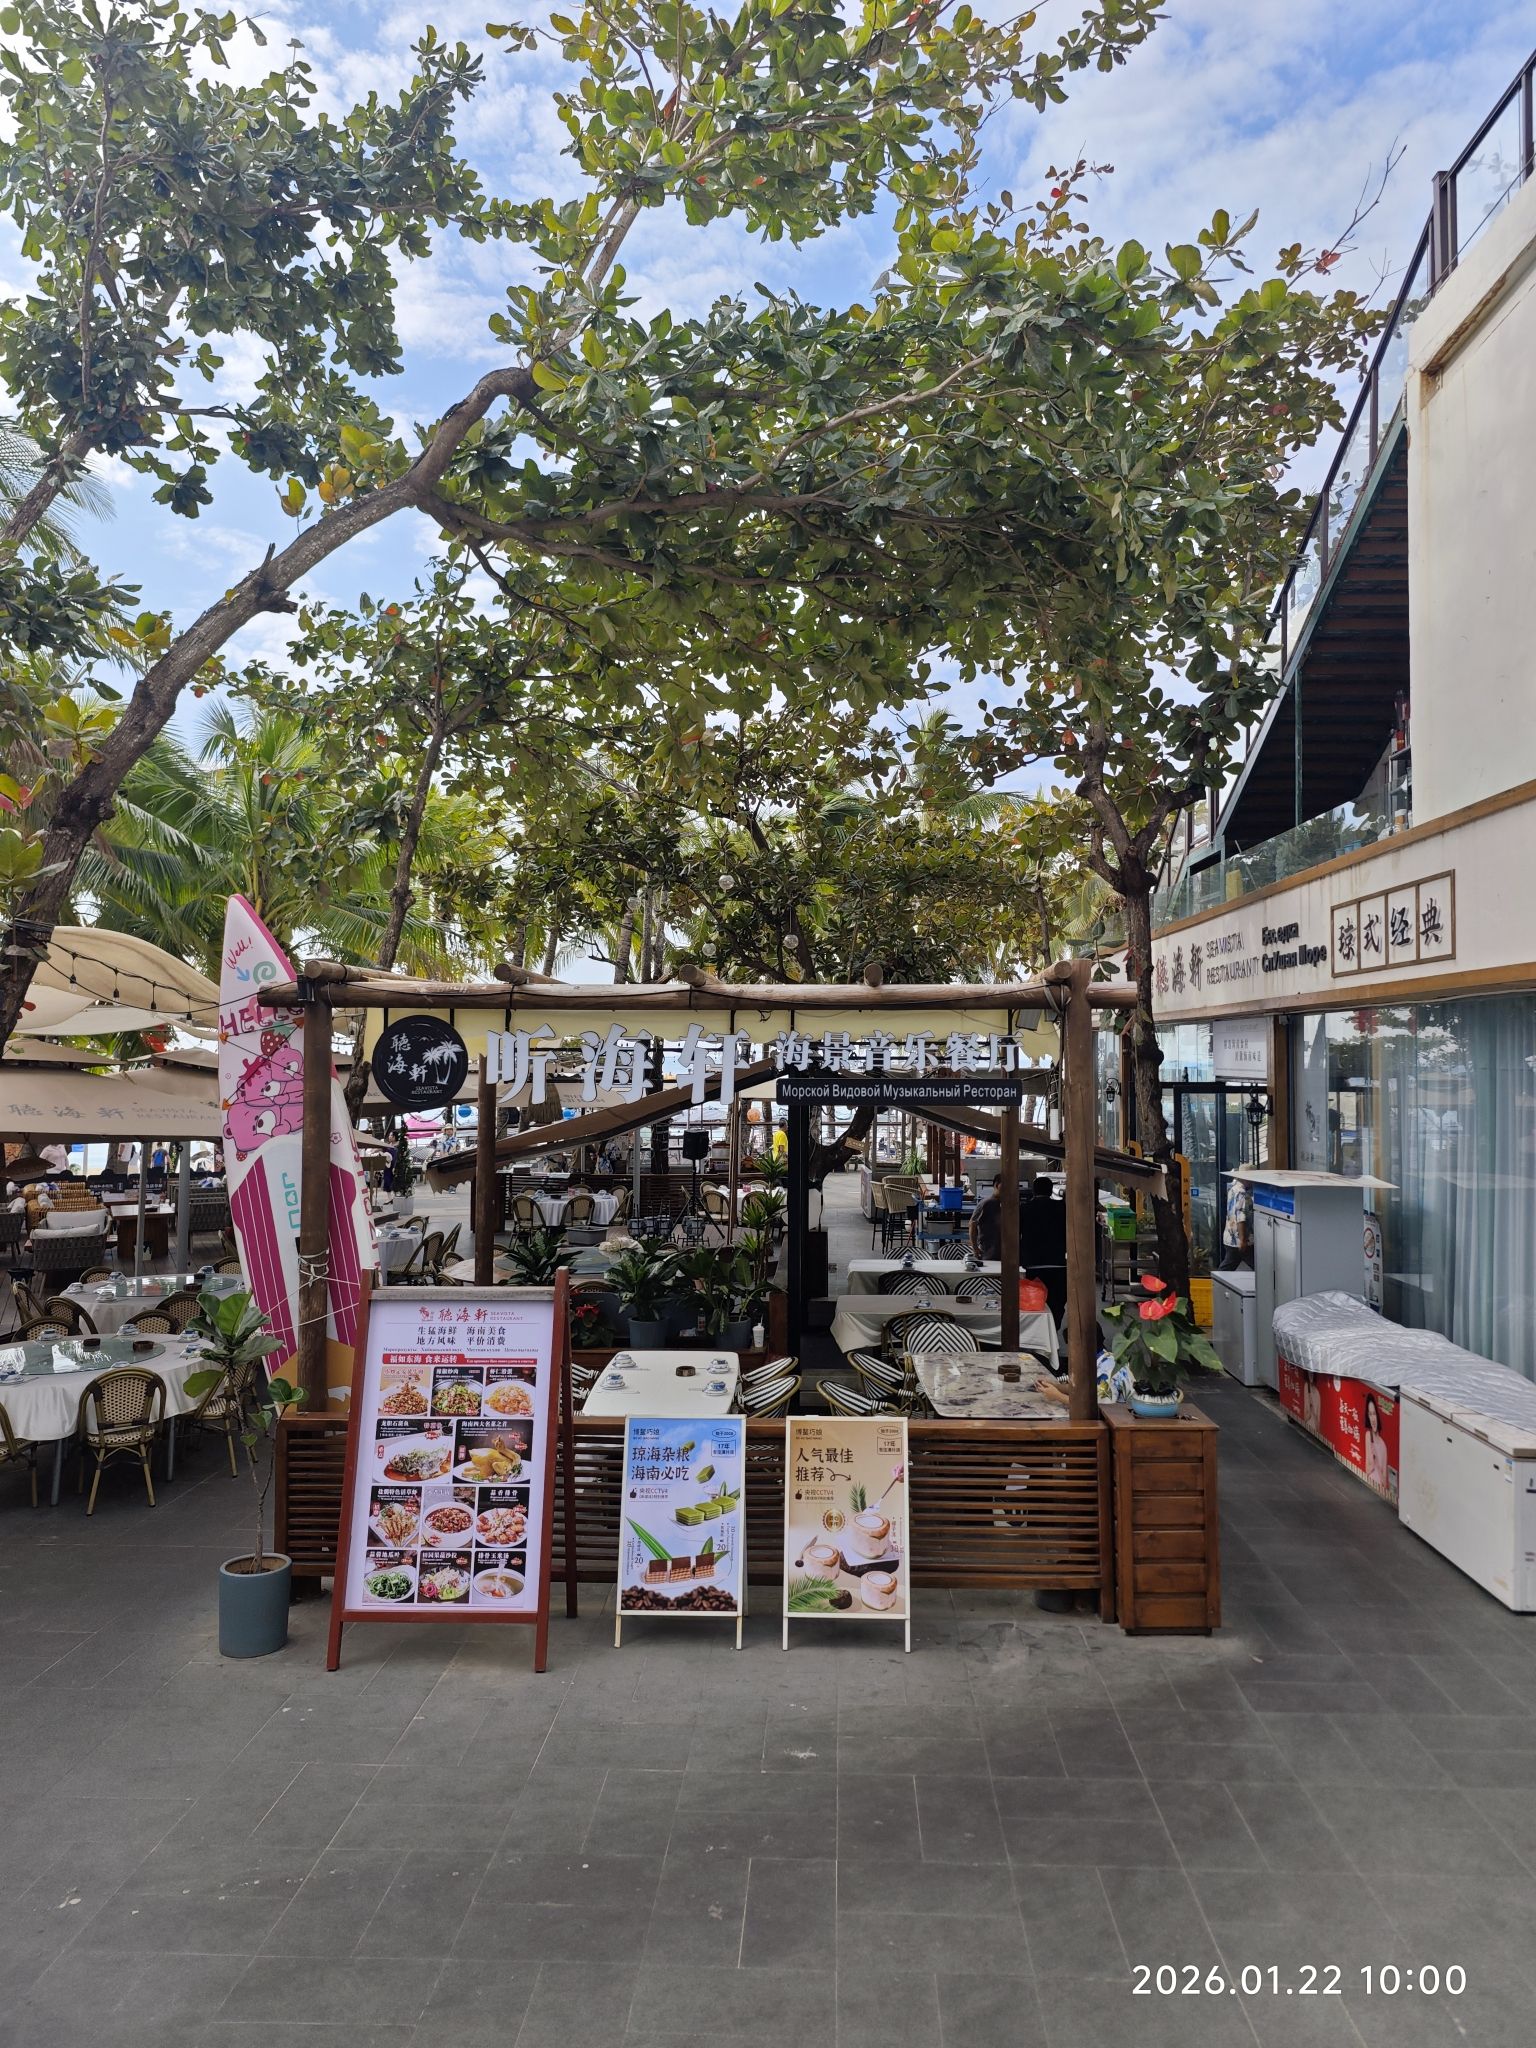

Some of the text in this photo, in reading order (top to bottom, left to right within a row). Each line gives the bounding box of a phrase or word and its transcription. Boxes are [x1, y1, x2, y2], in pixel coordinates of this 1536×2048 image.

[1338, 897, 1443, 961] 琼式经典
[224, 936, 254, 970] Well!
[774, 1030, 1024, 1072] 海景音乐餐厅
[486, 1023, 750, 1105] 听海轩
[782, 1084, 1017, 1100] Морской Видовой Музыкальный Ресторан
[418, 1326, 506, 1335] 生猛海鲜 海南美食
[416, 1336, 506, 1345] 地方风味 平价消费
[390, 1354, 421, 1364] 福如东海
[425, 1354, 458, 1364] 食来运转
[632, 1446, 690, 1461] 琼海杂粮
[796, 1448, 854, 1463] 人气最佳
[631, 1465, 690, 1481] 海南必吃
[795, 1466, 825, 1482] 推荐
